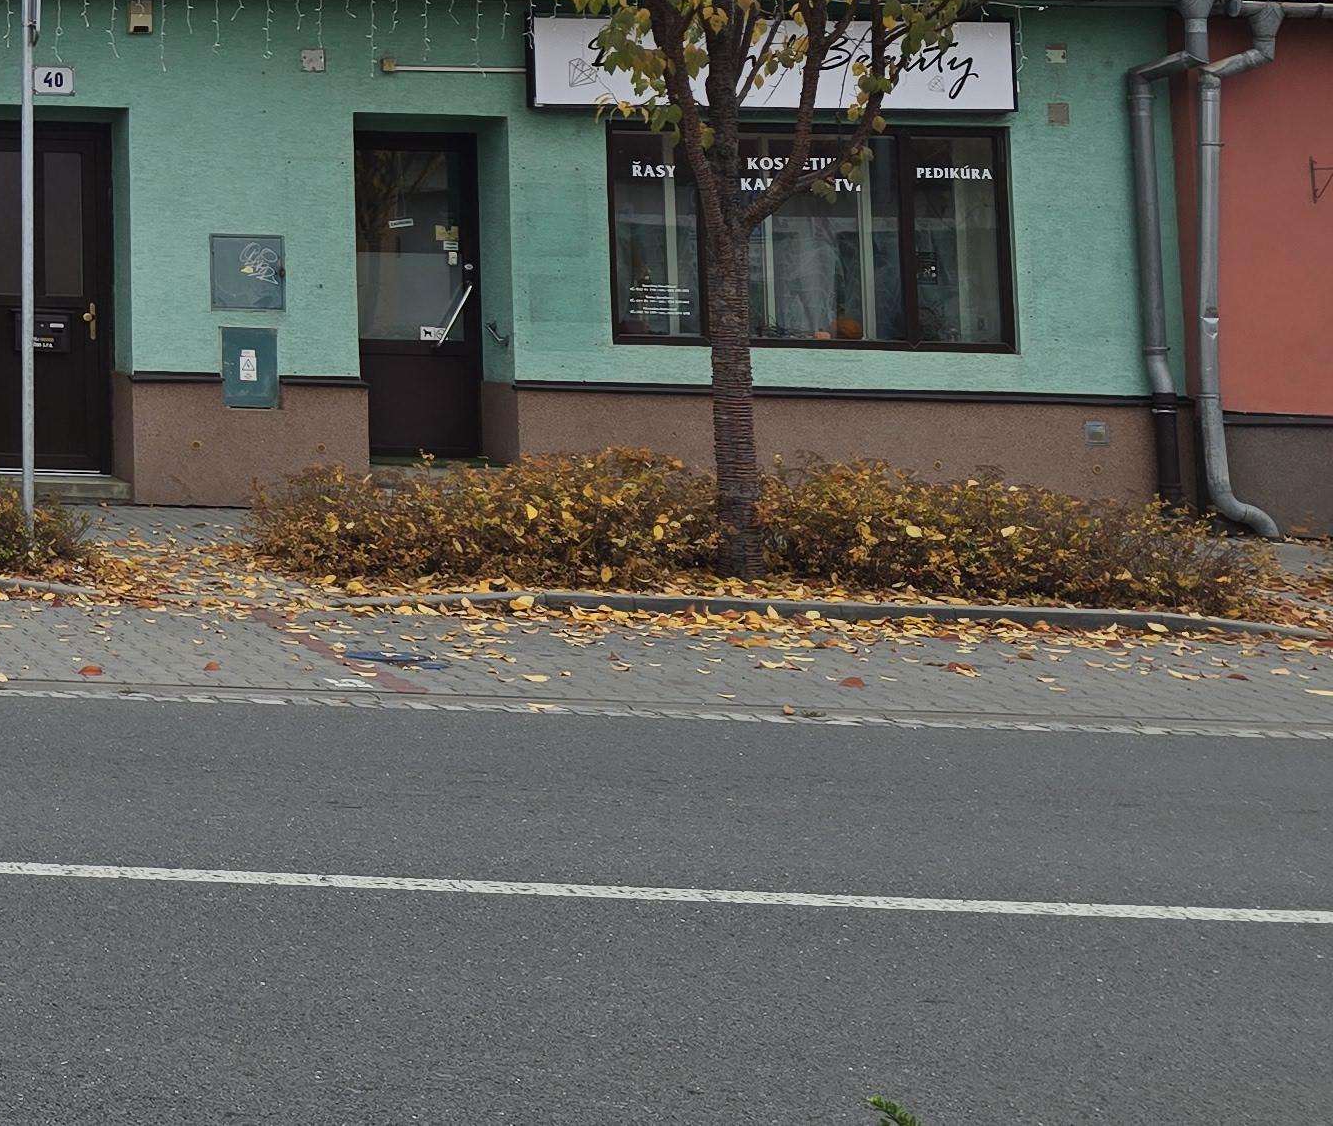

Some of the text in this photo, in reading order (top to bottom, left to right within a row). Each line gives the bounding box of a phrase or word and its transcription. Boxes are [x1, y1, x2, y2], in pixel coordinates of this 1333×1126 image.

[43, 72, 63, 87] 40
[632, 161, 675, 177] ŘASY
[917, 165, 993, 180] PEDIKÚRA
